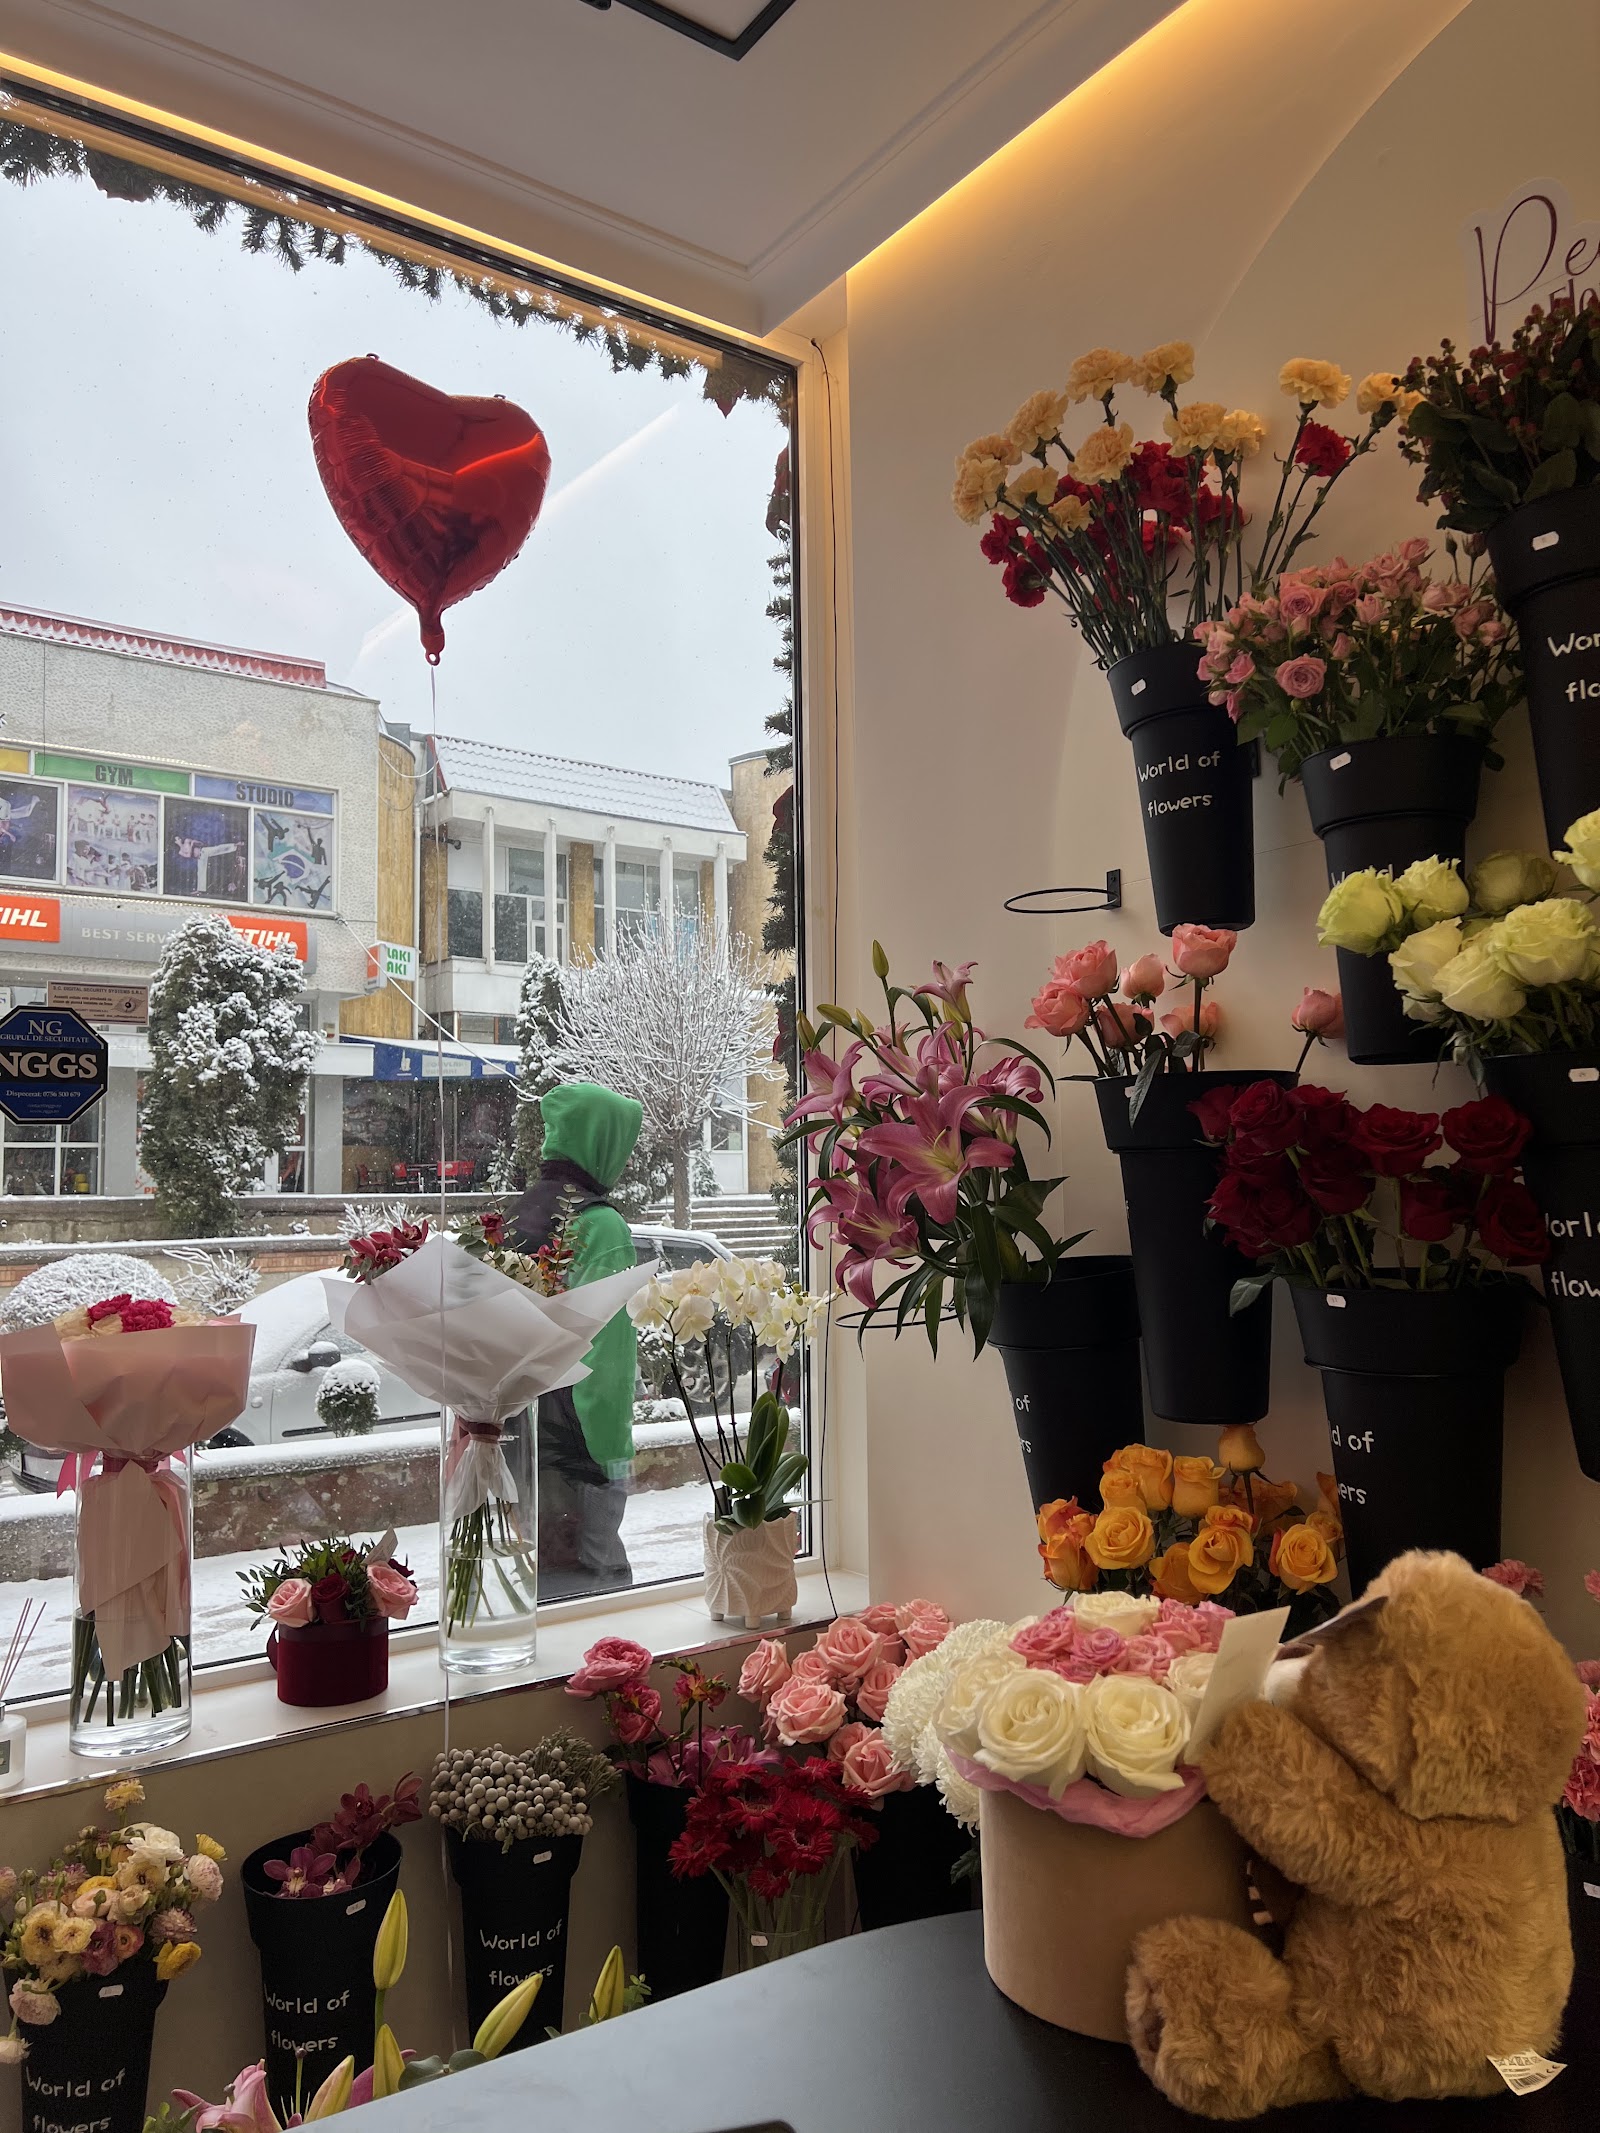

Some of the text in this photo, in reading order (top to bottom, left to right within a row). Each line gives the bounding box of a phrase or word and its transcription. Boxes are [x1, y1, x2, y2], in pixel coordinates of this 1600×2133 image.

[95, 764, 133, 786] GYM
[1137, 751, 1221, 783] World of
[236, 783, 294, 808] STUDIO
[1147, 793, 1213, 818] flowers
[81, 928, 121, 941] BEST
[0, 1033, 89, 1043] GRUPUL DE SECURITATE
[28, 1019, 63, 1036] NG
[0, 1051, 98, 1079] NGGS
[1347, 1430, 1375, 1454] of
[479, 1918, 563, 1951] World of
[264, 1984, 351, 2014] World of
[271, 2029, 339, 2053] flowers
[25, 2066, 127, 2098] World of
